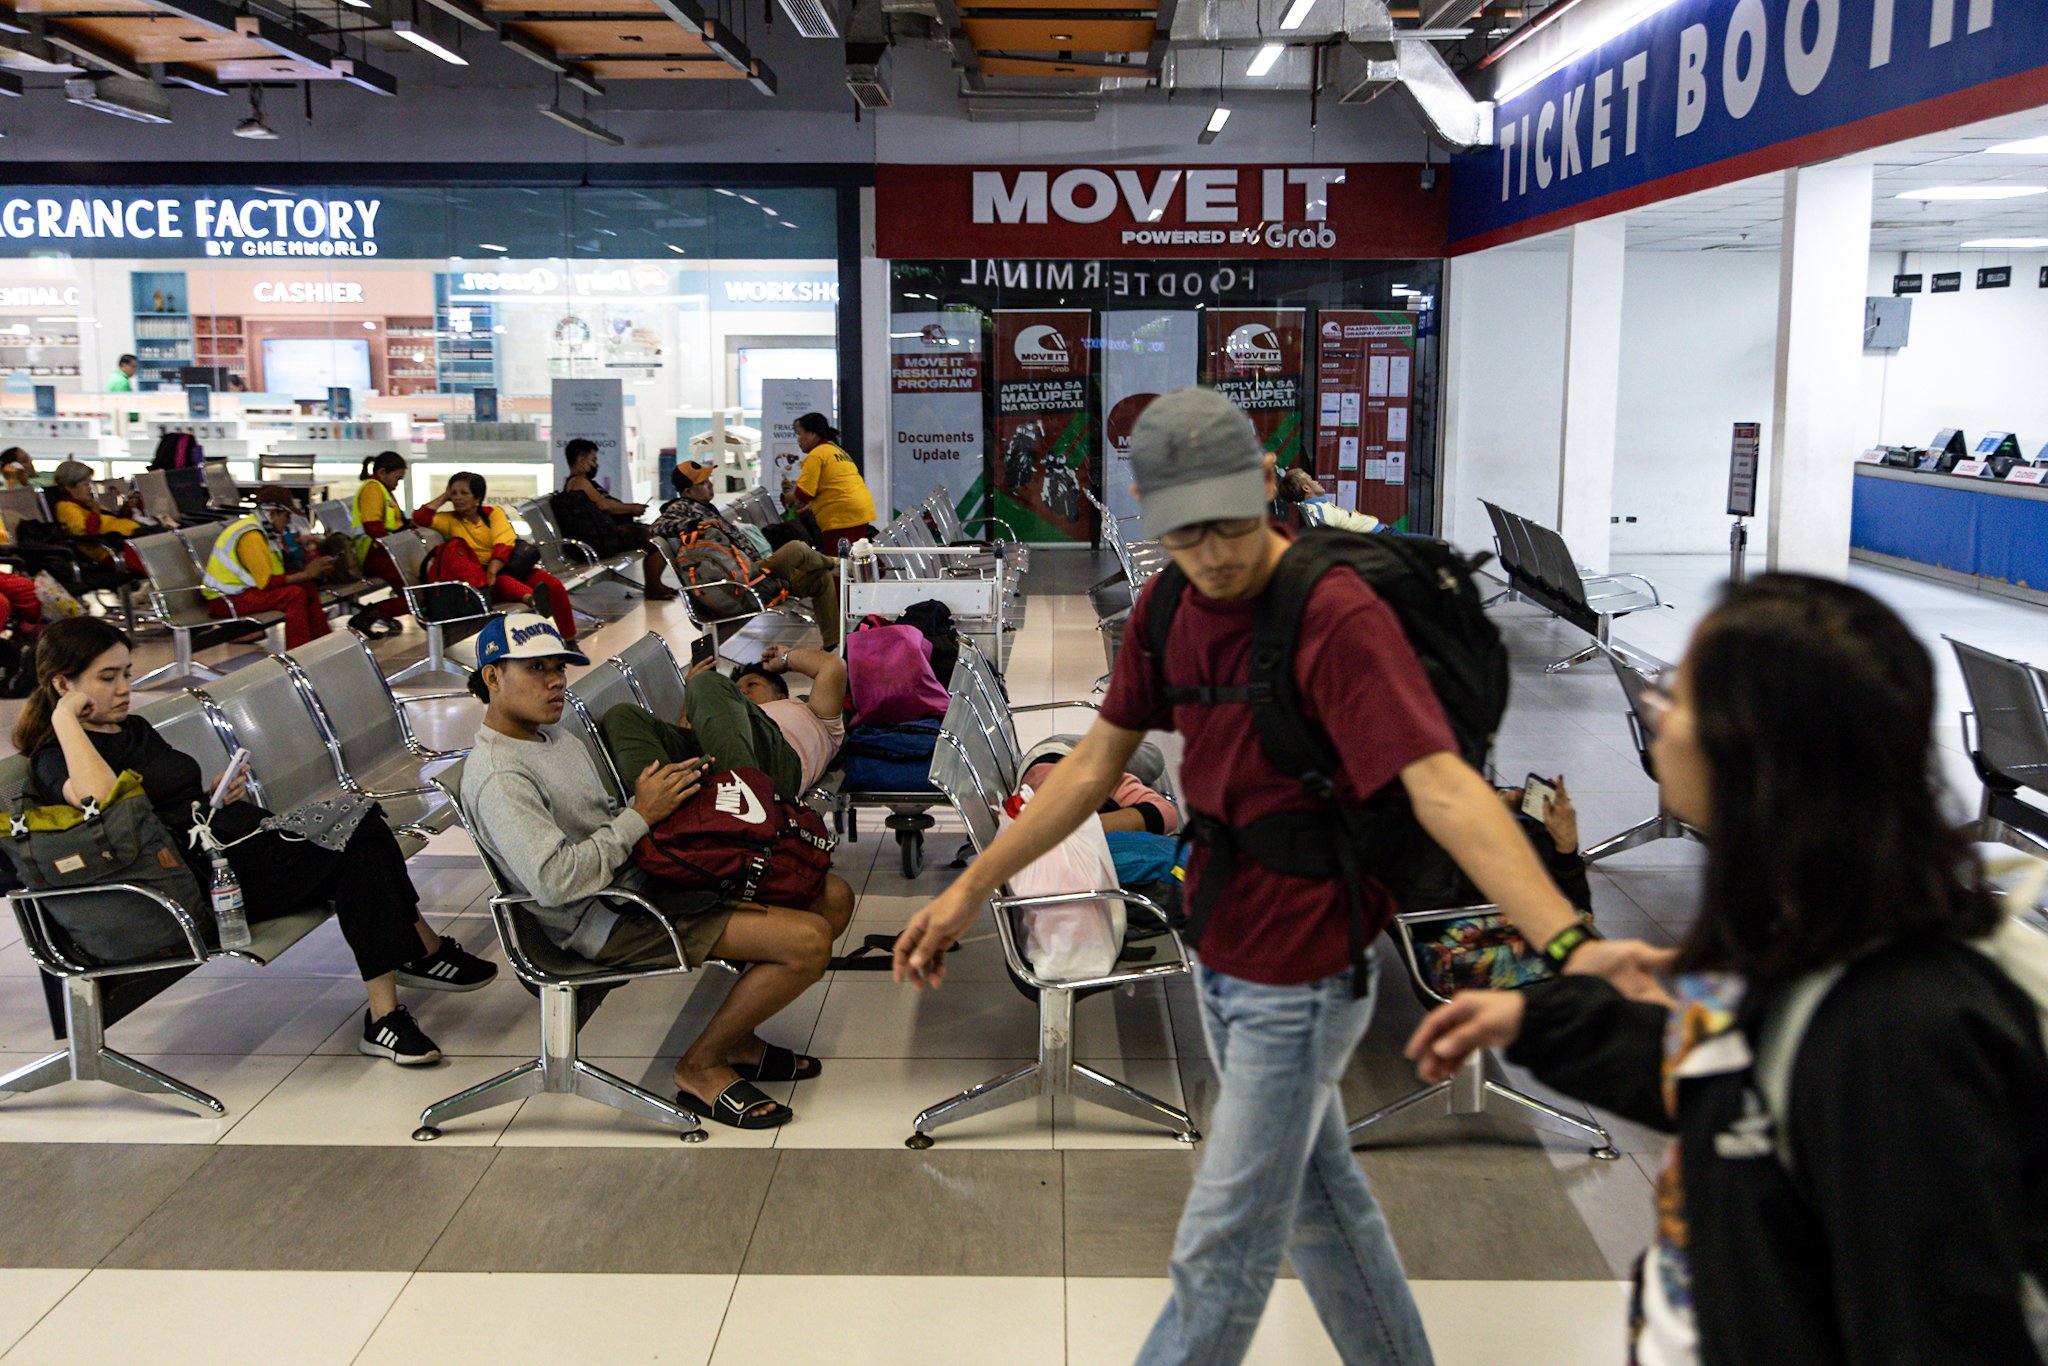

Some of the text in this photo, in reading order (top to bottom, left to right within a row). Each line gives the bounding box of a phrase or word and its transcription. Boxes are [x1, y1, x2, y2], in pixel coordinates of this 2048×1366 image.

[1500, 51, 1647, 203] TICKET
[972, 168, 1346, 224] MOVE IT
[0, 199, 381, 239] GRANCE FACTORY
[1122, 222, 1337, 249] POWERED BY Grab
[206, 241, 378, 256] BY CHEMWORLD
[254, 282, 364, 303] CASHIER
[904, 358, 964, 368] MOVE IT
[1021, 353, 1066, 361] MOVE IT
[892, 368, 977, 378] RESKILLING
[897, 378, 972, 389] PROGRAM
[1001, 381, 1082, 393] APPLY NA SA
[1214, 380, 1294, 392] APPLY NA SA
[1001, 390, 1083, 403] MALUPET
[1001, 403, 1019, 412] NA
[897, 431, 974, 444] Documents
[913, 449, 960, 463] Update
[715, 782, 742, 815] NIKE
